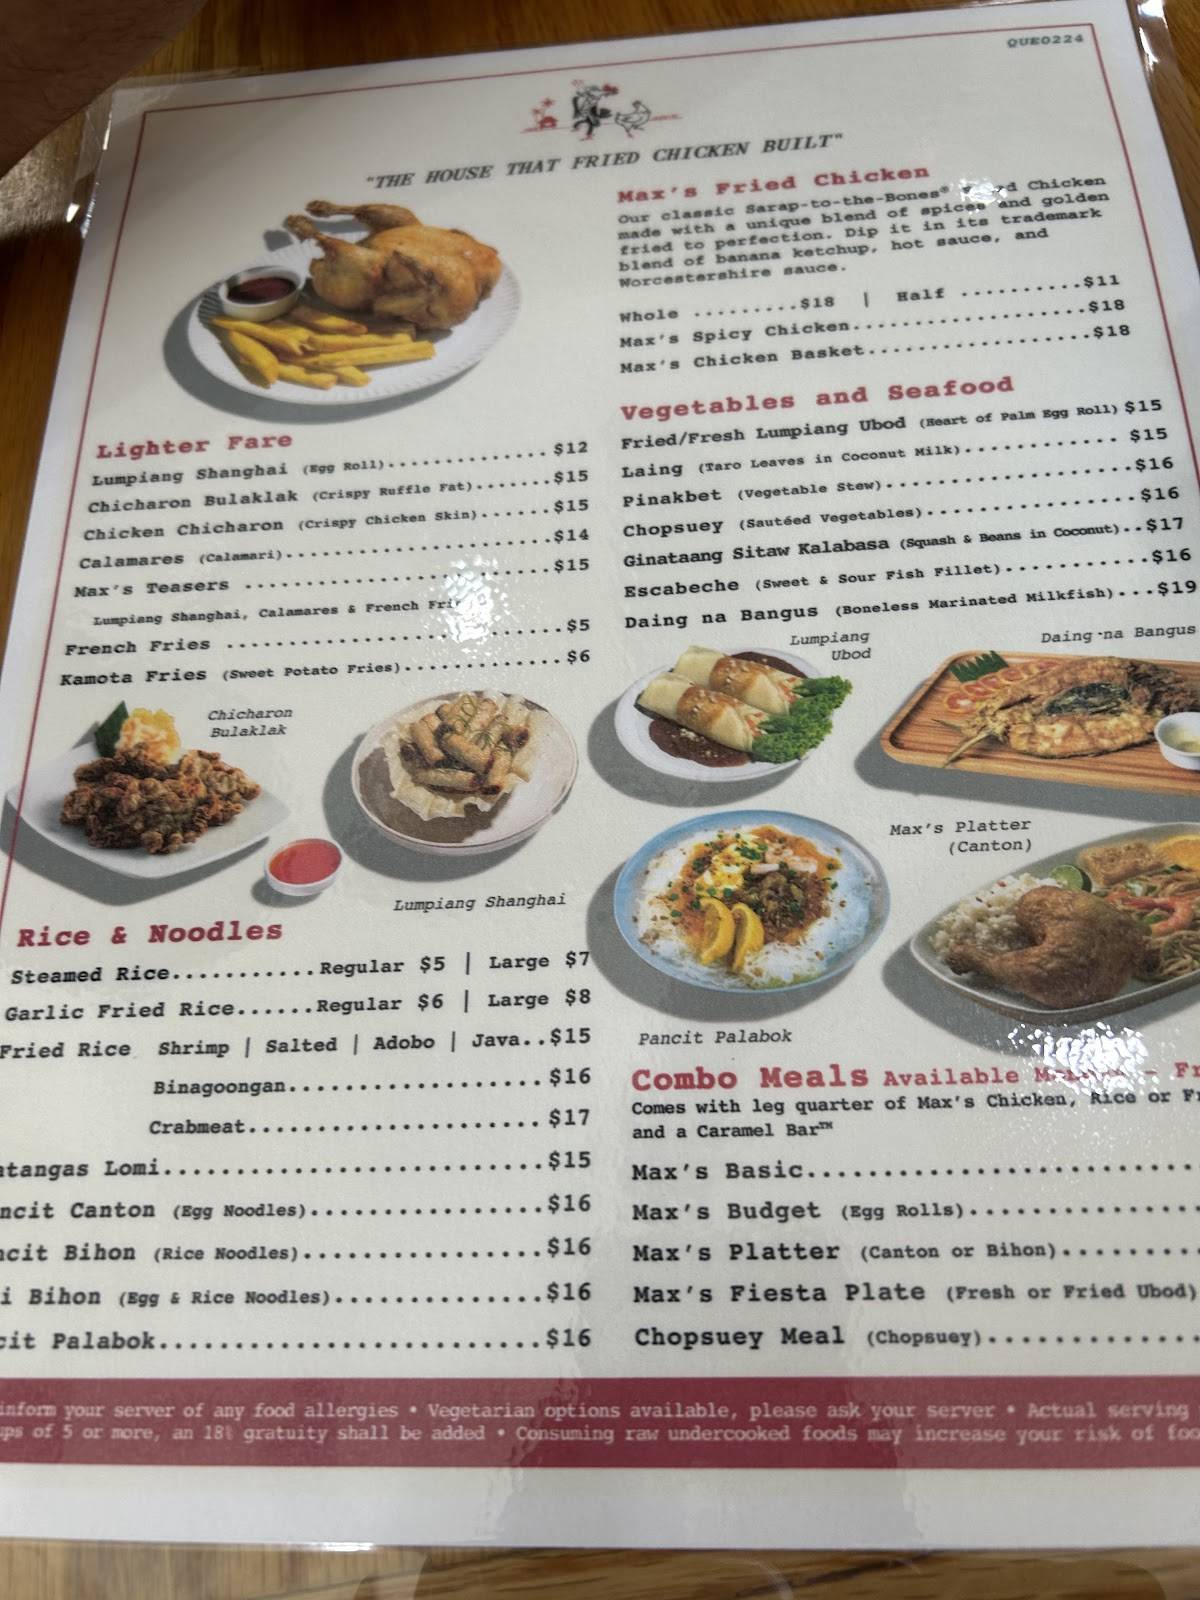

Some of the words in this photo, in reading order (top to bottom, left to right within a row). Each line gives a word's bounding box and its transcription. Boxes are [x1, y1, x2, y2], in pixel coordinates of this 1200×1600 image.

[366, 172, 416, 189] "THE
[424, 164, 494, 185] HOUSE
[507, 158, 562, 176] THAT
[571, 151, 641, 170] FRIED
[652, 141, 750, 162] CHICKEN
[762, 133, 843, 154] BUILT"
[617, 186, 698, 204] Max's
[715, 175, 797, 196] Fried
[813, 167, 930, 187] Chicken
[617, 214, 651, 225] Our
[660, 206, 735, 221] classic
[1027, 177, 1107, 191] Chicken
[618, 256, 674, 272] blend
[683, 254, 705, 267] of
[715, 251, 781, 264] banana
[791, 244, 877, 259] ketchup,
[890, 239, 925, 251] hot
[936, 234, 1000, 247] sauce,
[1014, 227, 1049, 240] and
[618, 267, 772, 289] Worcestershire
[783, 263, 846, 276] sauce.
[619, 308, 679, 323] Whole
[800, 295, 835, 311] $18
[896, 287, 945, 302] Half
[1083, 274, 1120, 289] $11
[619, 359, 680, 374] Max's
[693, 352, 779, 368] Chicken
[790, 344, 865, 361] Basket
[1093, 324, 1131, 340] $18
[620, 394, 795, 423] Vegetables
[815, 386, 869, 406] and
[887, 375, 1015, 401] Seafood
[96, 439, 210, 461] Lighter
[227, 434, 293, 451] Fare
[91, 471, 184, 488] Lumpiang
[195, 462, 288, 481] Shanghai
[302, 464, 336, 476] (Egg
[343, 459, 385, 472] Roll)
[553, 440, 588, 457] $12
[622, 489, 722, 508] Pinakbet
[737, 483, 828, 501] (Vegetable
[836, 480, 882, 493] Stew)
[1135, 456, 1174, 473] $16
[83, 526, 165, 542] Chicken
[176, 520, 284, 537] Chicharon
[298, 518, 357, 531] (Crispy
[364, 513, 427, 526] Chicken
[434, 510, 477, 522] Skin)
[553, 498, 589, 515] $15
[622, 520, 724, 538] Chopsuey
[739, 514, 812, 531] (Sautéed
[819, 507, 922, 525] Vegetables)
[1140, 486, 1180, 503] $16
[78, 554, 185, 570] Calamares
[199, 549, 283, 565] (Calamari)
[553, 528, 590, 545] $14
[73, 584, 134, 598] Max's
[146, 580, 230, 595] Teasers
[554, 558, 590, 574] $15
[624, 613, 689, 630] Daing
[701, 613, 727, 624] na
[740, 606, 819, 623] Bangus
[835, 601, 920, 618] (Boneless
[928, 593, 1018, 609] Marinated
[1025, 587, 1113, 603] Milkfish)
[1157, 580, 1198, 597] $19
[64, 640, 137, 657] French
[149, 637, 211, 653] Fries
[566, 618, 590, 634] $5
[789, 631, 871, 647] Lumpiang
[1040, 630, 1094, 644] Daing
[1103, 629, 1124, 640] na
[1134, 625, 1197, 639] Bangus
[59, 671, 133, 687] Kamota
[145, 668, 207, 683] Fries
[222, 668, 275, 682] (Sweet
[283, 665, 339, 677] Potato
[347, 662, 400, 674] Fries)
[566, 649, 591, 665] $6
[831, 647, 872, 661] Ubod
[207, 708, 293, 721] Chicharon
[209, 723, 287, 738] Bulaklak
[889, 822, 944, 836] Max's
[954, 819, 1032, 833] Platter
[949, 838, 1032, 856] (Canton)
[392, 897, 477, 914] Lumpiang
[484, 892, 567, 910] Shanghai
[16, 925, 91, 948] Rice
[110, 926, 128, 945] &
[147, 920, 283, 944] Noodles
[10, 966, 103, 985] Steamed
[115, 964, 170, 981] Rice
[319, 959, 405, 978] Regular
[419, 955, 446, 974] $5
[489, 956, 550, 972] Large
[565, 949, 592, 970] $7
[0, 1041, 65, 1060] Fried
[77, 1040, 132, 1057] Rice
[157, 1039, 230, 1059] Shrimp
[265, 1036, 338, 1054] Salted
[372, 1034, 436, 1051] Adobo
[471, 1033, 521, 1048] Java
[550, 1027, 591, 1047] $15
[638, 1029, 704, 1046] Pancit
[714, 1028, 793, 1044] Palabok
[153, 1079, 286, 1098] Binagoongan
[549, 1067, 591, 1088] $16
[631, 1065, 738, 1092] Combo
[759, 1063, 869, 1089] Meals
[882, 1066, 1020, 1087] Available
[148, 1118, 246, 1135] Crabmeat
[548, 1107, 590, 1129] $17
[103, 1157, 160, 1177] Lomi
[548, 1150, 591, 1172] $15
[631, 1163, 709, 1181] Max's
[725, 1159, 803, 1180] Basic
[69, 1201, 156, 1219] Canton
[173, 1204, 214, 1221] (Egg
[223, 1203, 306, 1219] Noodles)
[547, 1193, 591, 1215] $16
[631, 1203, 710, 1221] Max's
[727, 1200, 822, 1224] Budget
[841, 1205, 885, 1222] (Egg
[895, 1202, 964, 1219] Rolls)
[632, 1244, 712, 1262] Max's
[728, 1242, 841, 1261] Platter
[860, 1245, 940, 1263] (Canton
[951, 1246, 975, 1259] or
[986, 1241, 1056, 1260] Bihon)
[51, 1330, 155, 1350] Palabok
[546, 1327, 592, 1350] $16
[634, 1326, 764, 1351] Chopsuey
[780, 1325, 845, 1345] Meal
[866, 1329, 982, 1348] (Chopsuey)
[64, 1404, 106, 1421] your
[113, 1405, 176, 1418] server
[182, 1402, 205, 1418] of
[213, 1405, 246, 1422] any
[253, 1401, 296, 1418] food
[303, 1402, 399, 1422] allergies
[427, 1402, 535, 1422] Vegetarian
[543, 1402, 621, 1422] options
[629, 1401, 738, 1421] available,
[749, 1401, 818, 1422] please
[826, 1401, 862, 1419] ask
[870, 1405, 917, 1422] your
[926, 1404, 996, 1419] server
[1027, 1401, 1098, 1419] Actual
[1107, 1400, 1190, 1422] serving
